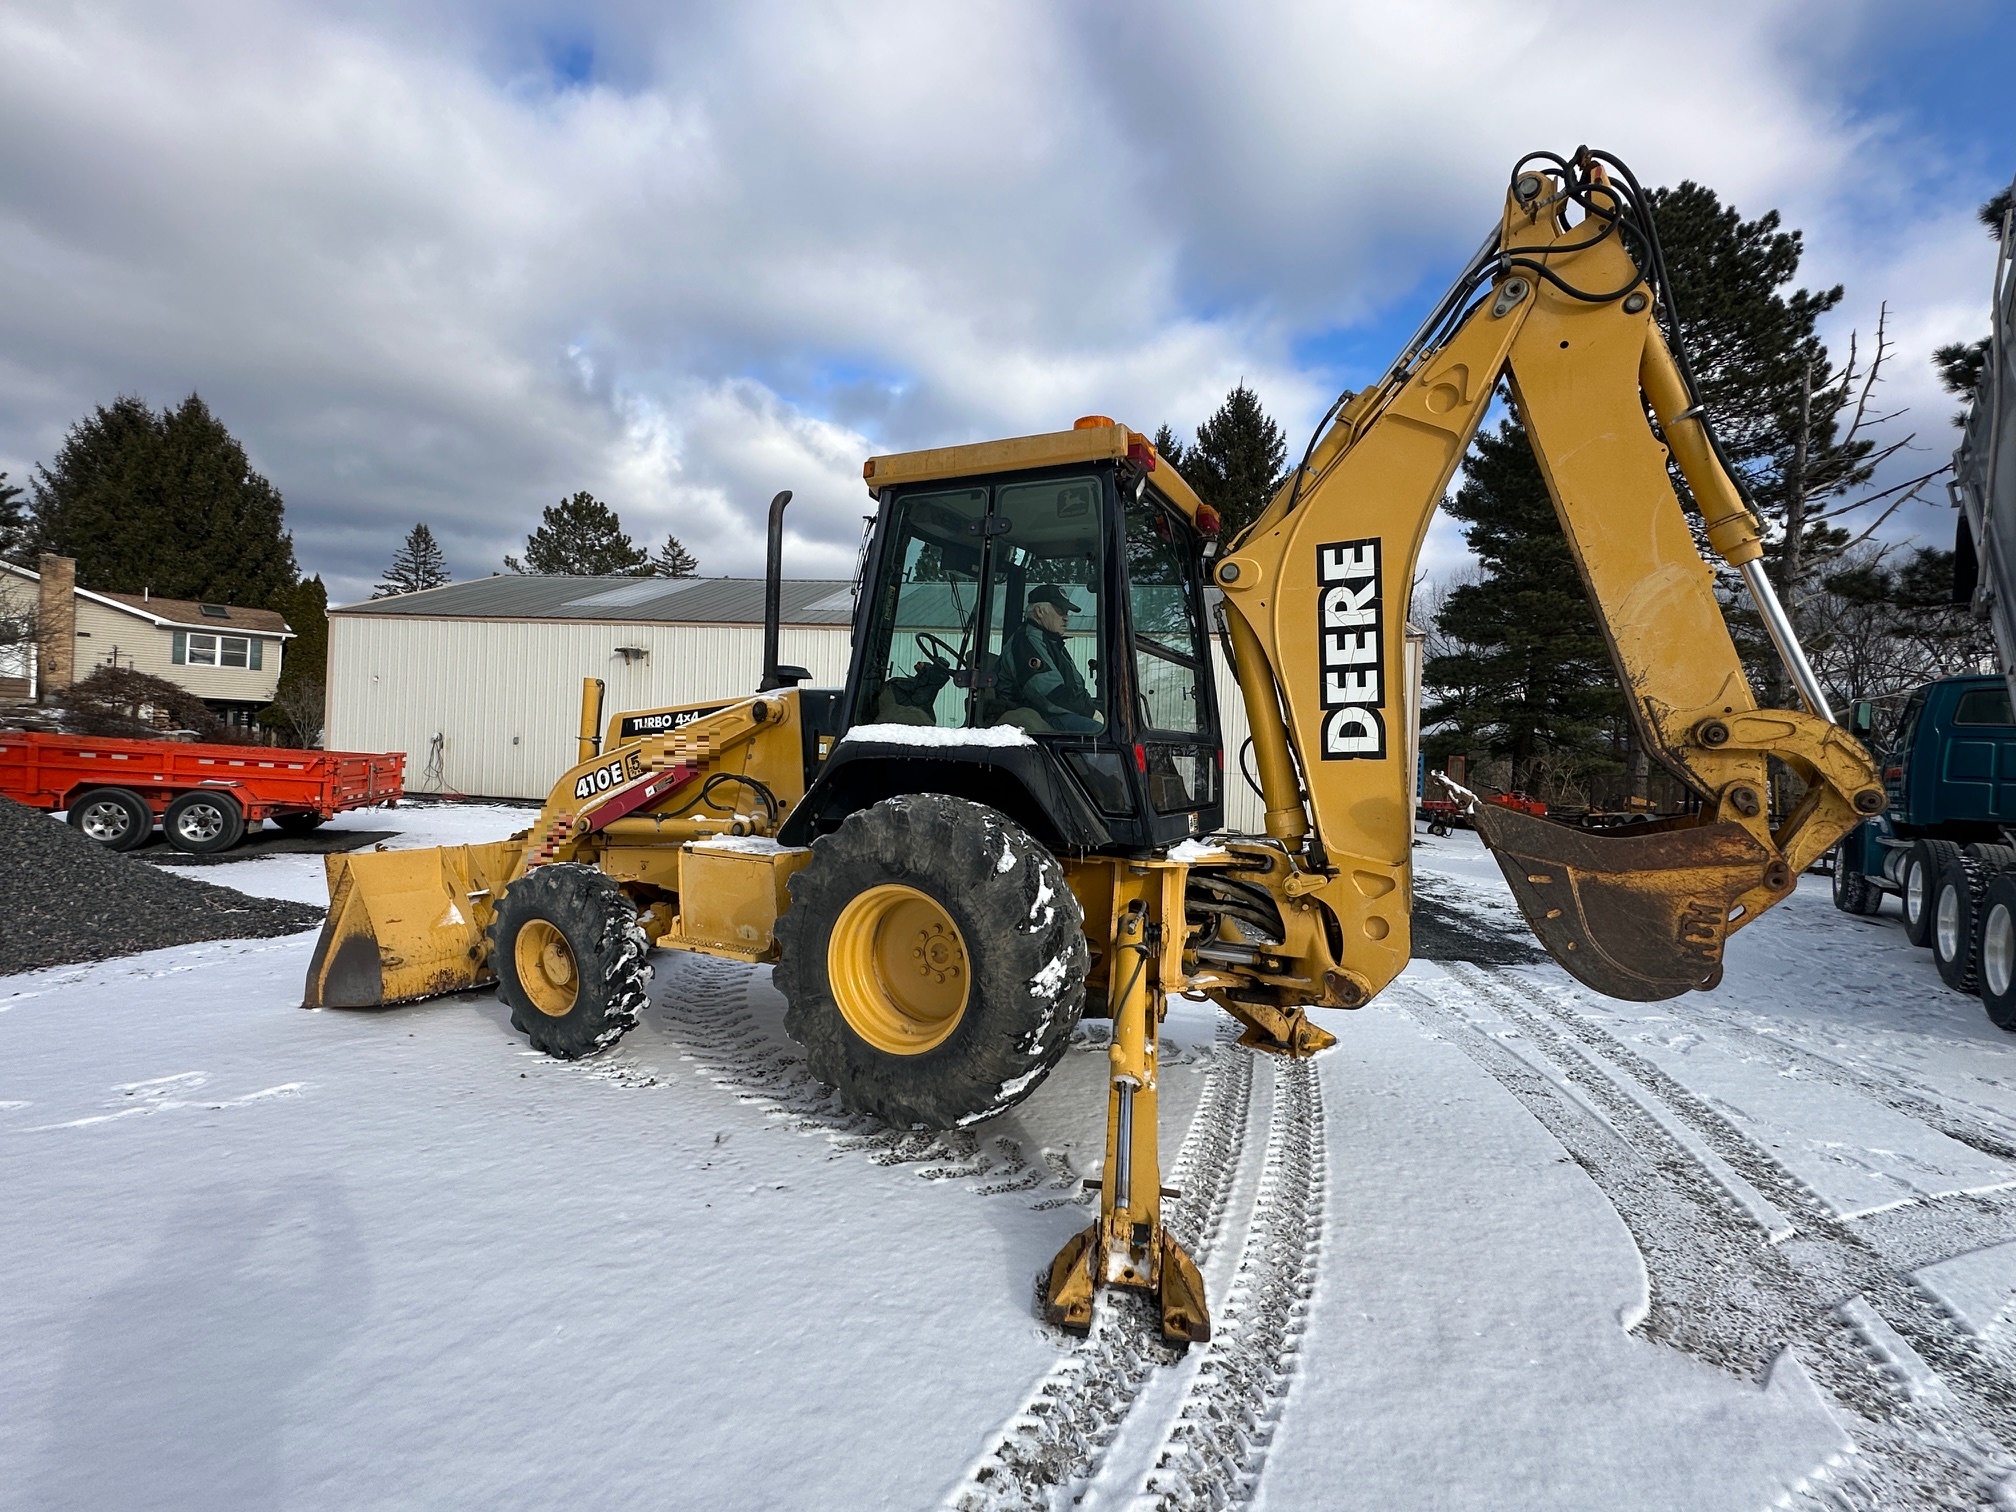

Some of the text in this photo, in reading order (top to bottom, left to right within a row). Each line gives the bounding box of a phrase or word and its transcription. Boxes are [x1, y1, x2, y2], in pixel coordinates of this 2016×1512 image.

[1323, 544, 1379, 753] DEERE
[633, 711, 699, 731] TURBO 4x4
[575, 761, 624, 799] 410E
